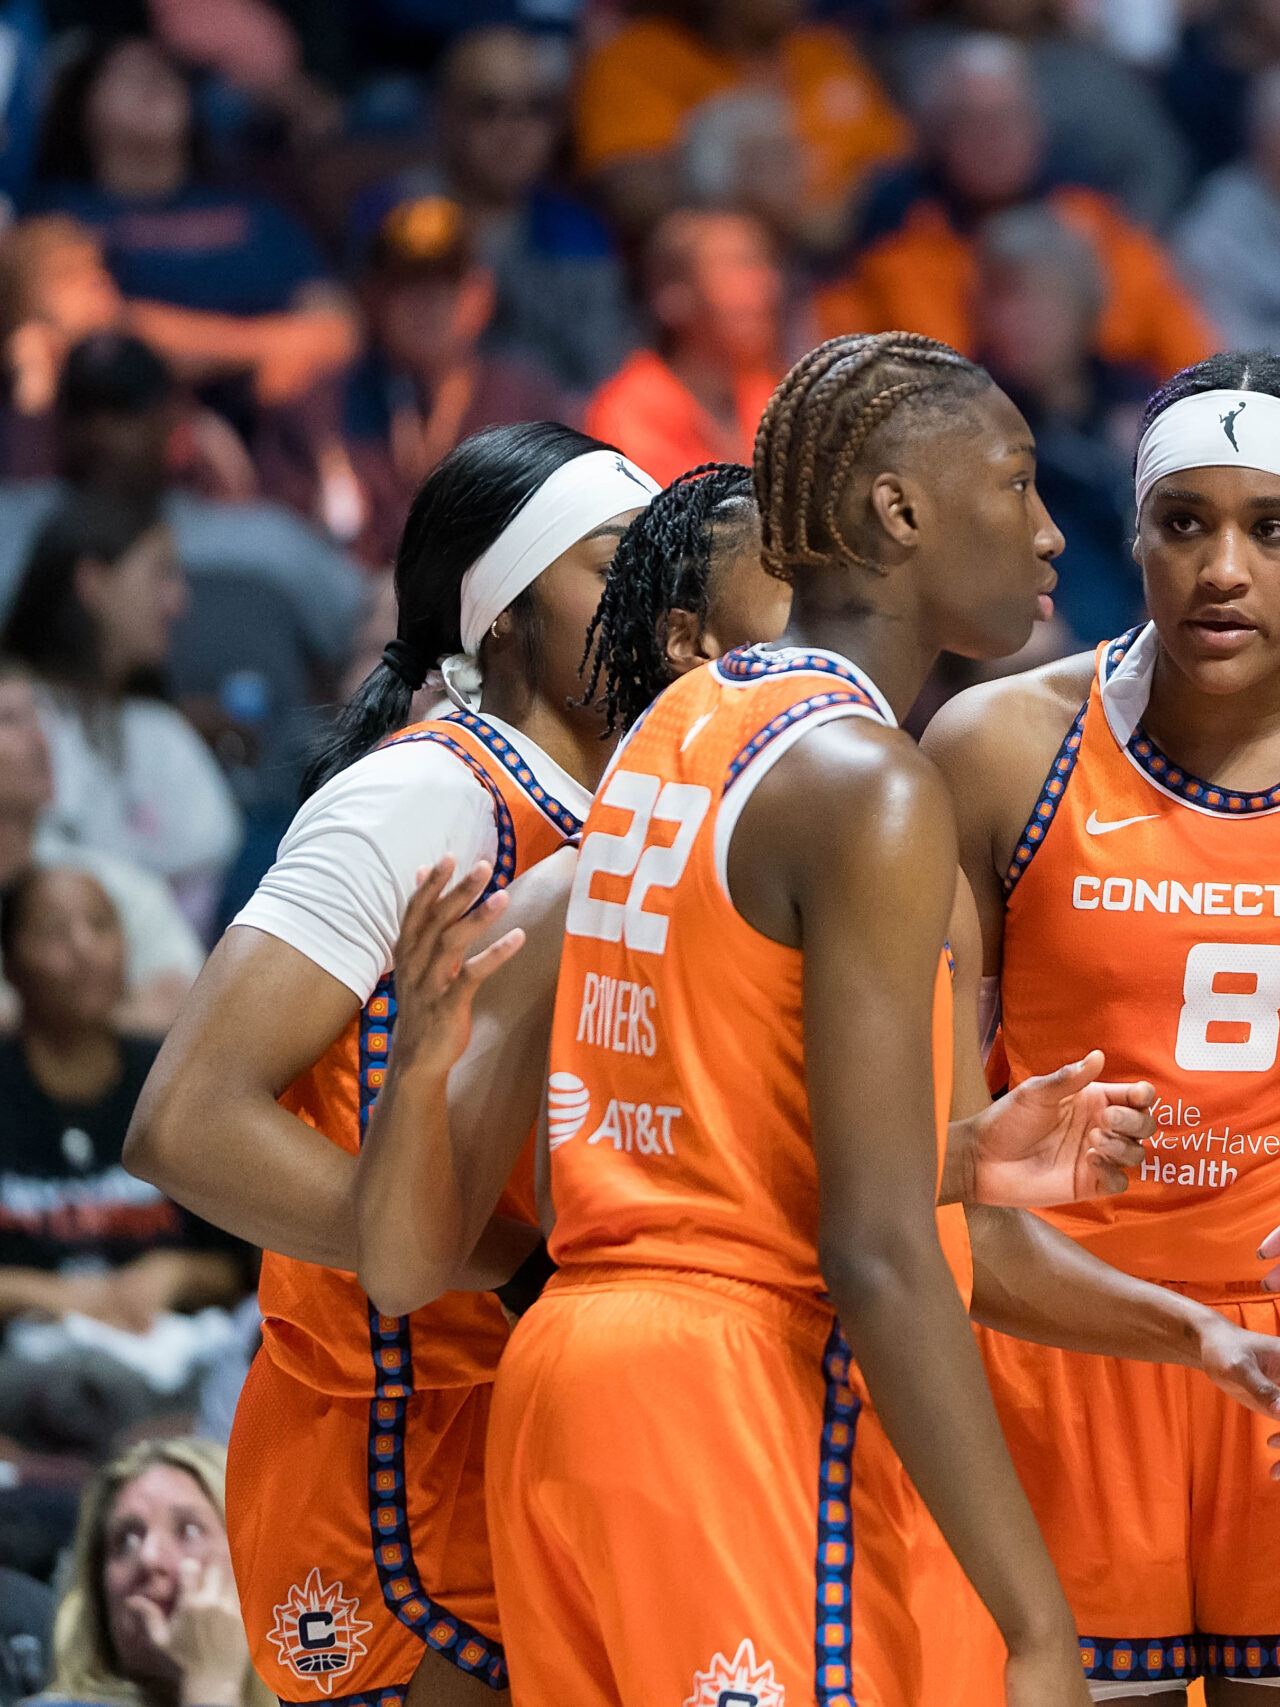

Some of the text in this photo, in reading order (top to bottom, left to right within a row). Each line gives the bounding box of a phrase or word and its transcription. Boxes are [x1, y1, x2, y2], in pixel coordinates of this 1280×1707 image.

[566, 770, 712, 955] 22
[576, 971, 656, 1057] RIVERS
[587, 1098, 683, 1155] AT&T
[1140, 1155, 1238, 1187] Health
[298, 1611, 336, 1650] C
